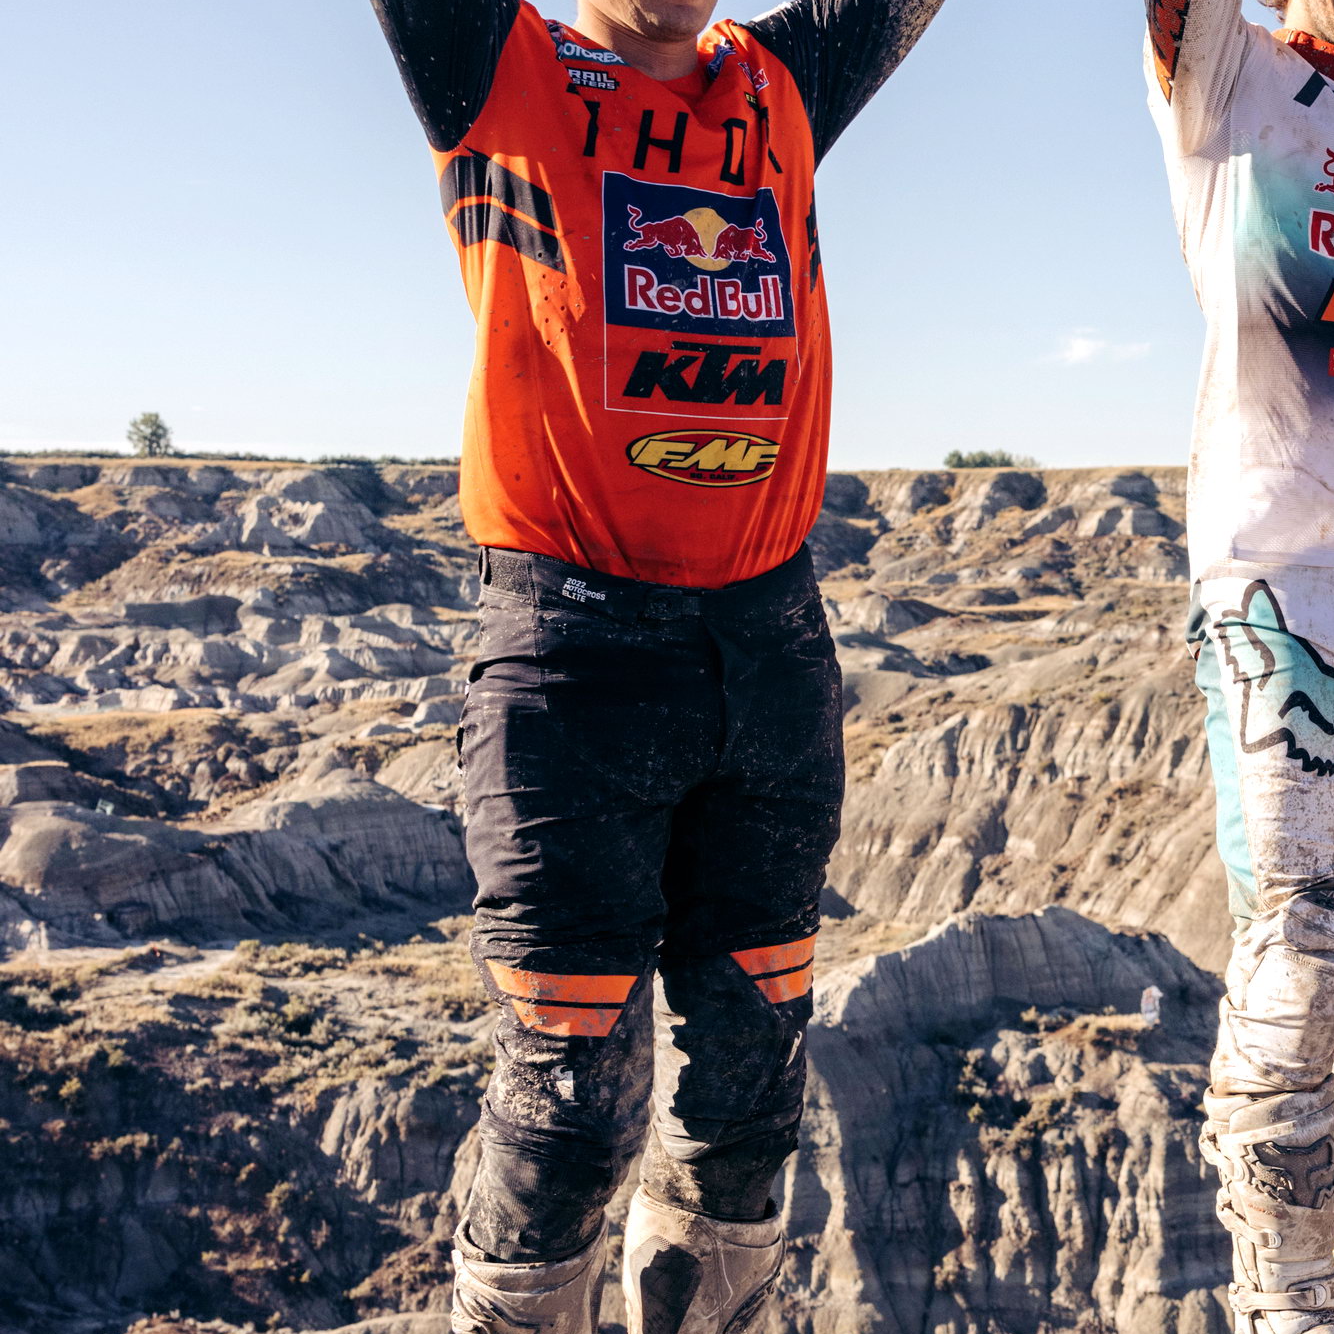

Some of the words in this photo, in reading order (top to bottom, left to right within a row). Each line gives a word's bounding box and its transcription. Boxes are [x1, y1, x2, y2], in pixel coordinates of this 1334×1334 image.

[624, 264, 714, 318] Red
[715, 275, 784, 321] Bull
[622, 341, 788, 405] KTM
[630, 438, 781, 473] FMF
[562, 589, 586, 603] ELITE
[563, 583, 606, 601] MOTOCROSS
[566, 577, 587, 589] 2022
